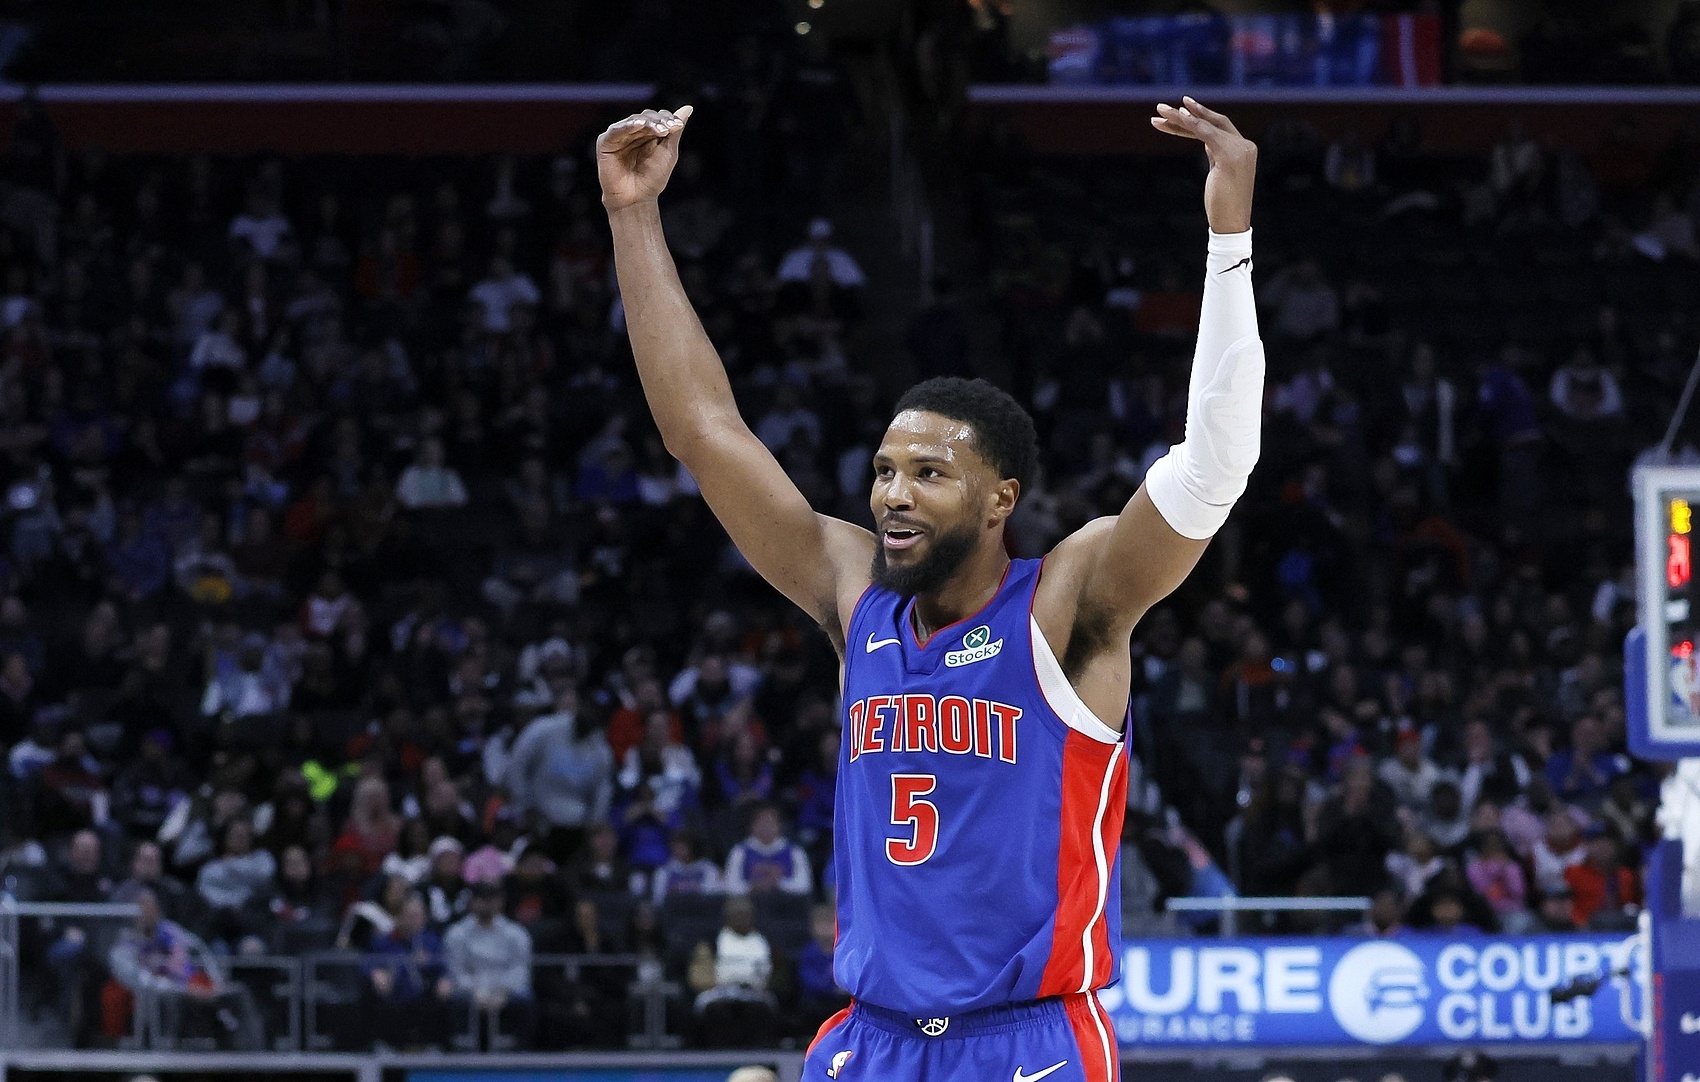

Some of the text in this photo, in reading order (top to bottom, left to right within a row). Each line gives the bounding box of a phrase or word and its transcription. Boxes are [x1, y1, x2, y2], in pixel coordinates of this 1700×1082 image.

[849, 693, 1023, 764] DETROIT
[885, 773, 939, 866] 5
[1113, 1015, 1254, 1043] URANCE
[1436, 991, 1593, 1039] CLUB
